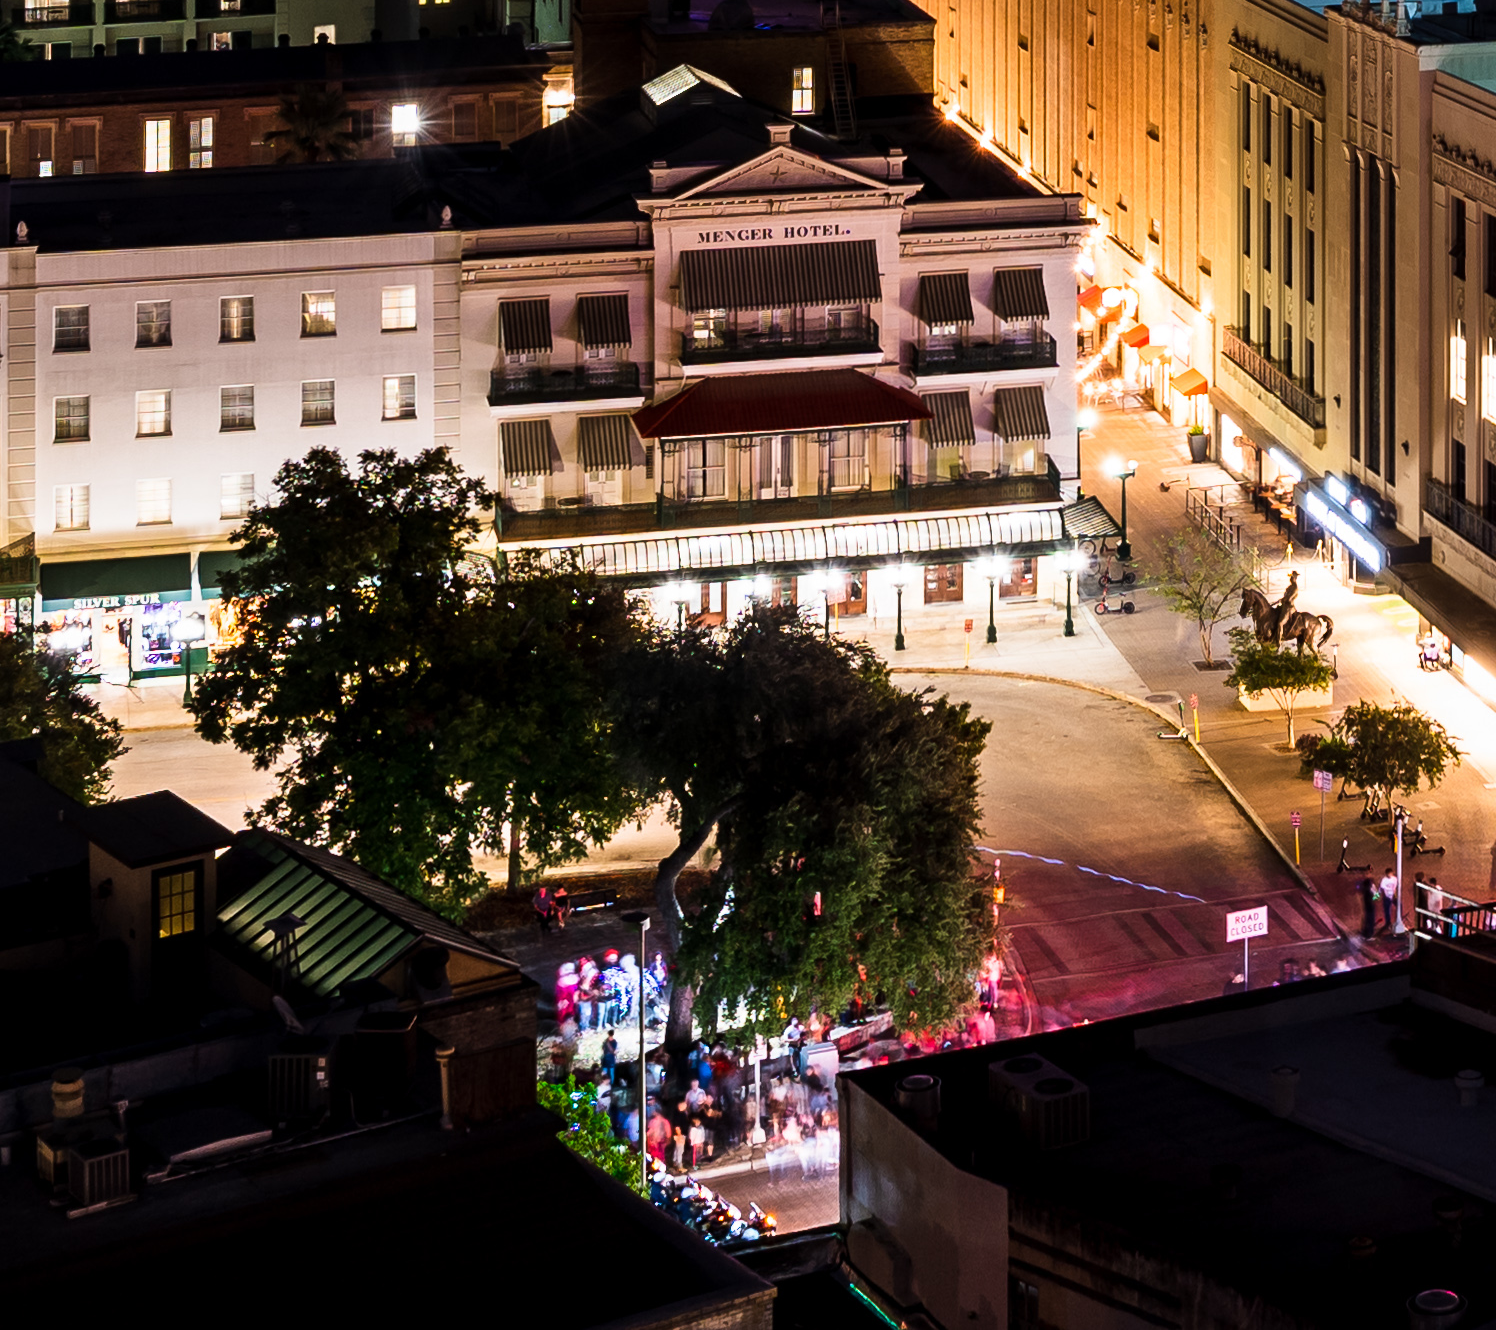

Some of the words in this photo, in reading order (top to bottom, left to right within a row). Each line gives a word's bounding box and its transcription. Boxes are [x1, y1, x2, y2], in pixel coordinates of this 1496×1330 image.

[697, 228, 774, 244] MENGER
[73, 595, 121, 610] SILVER
[124, 592, 161, 606] SPUR
[1235, 912, 1259, 924] ROAD
[1230, 922, 1264, 936] CLOSED
